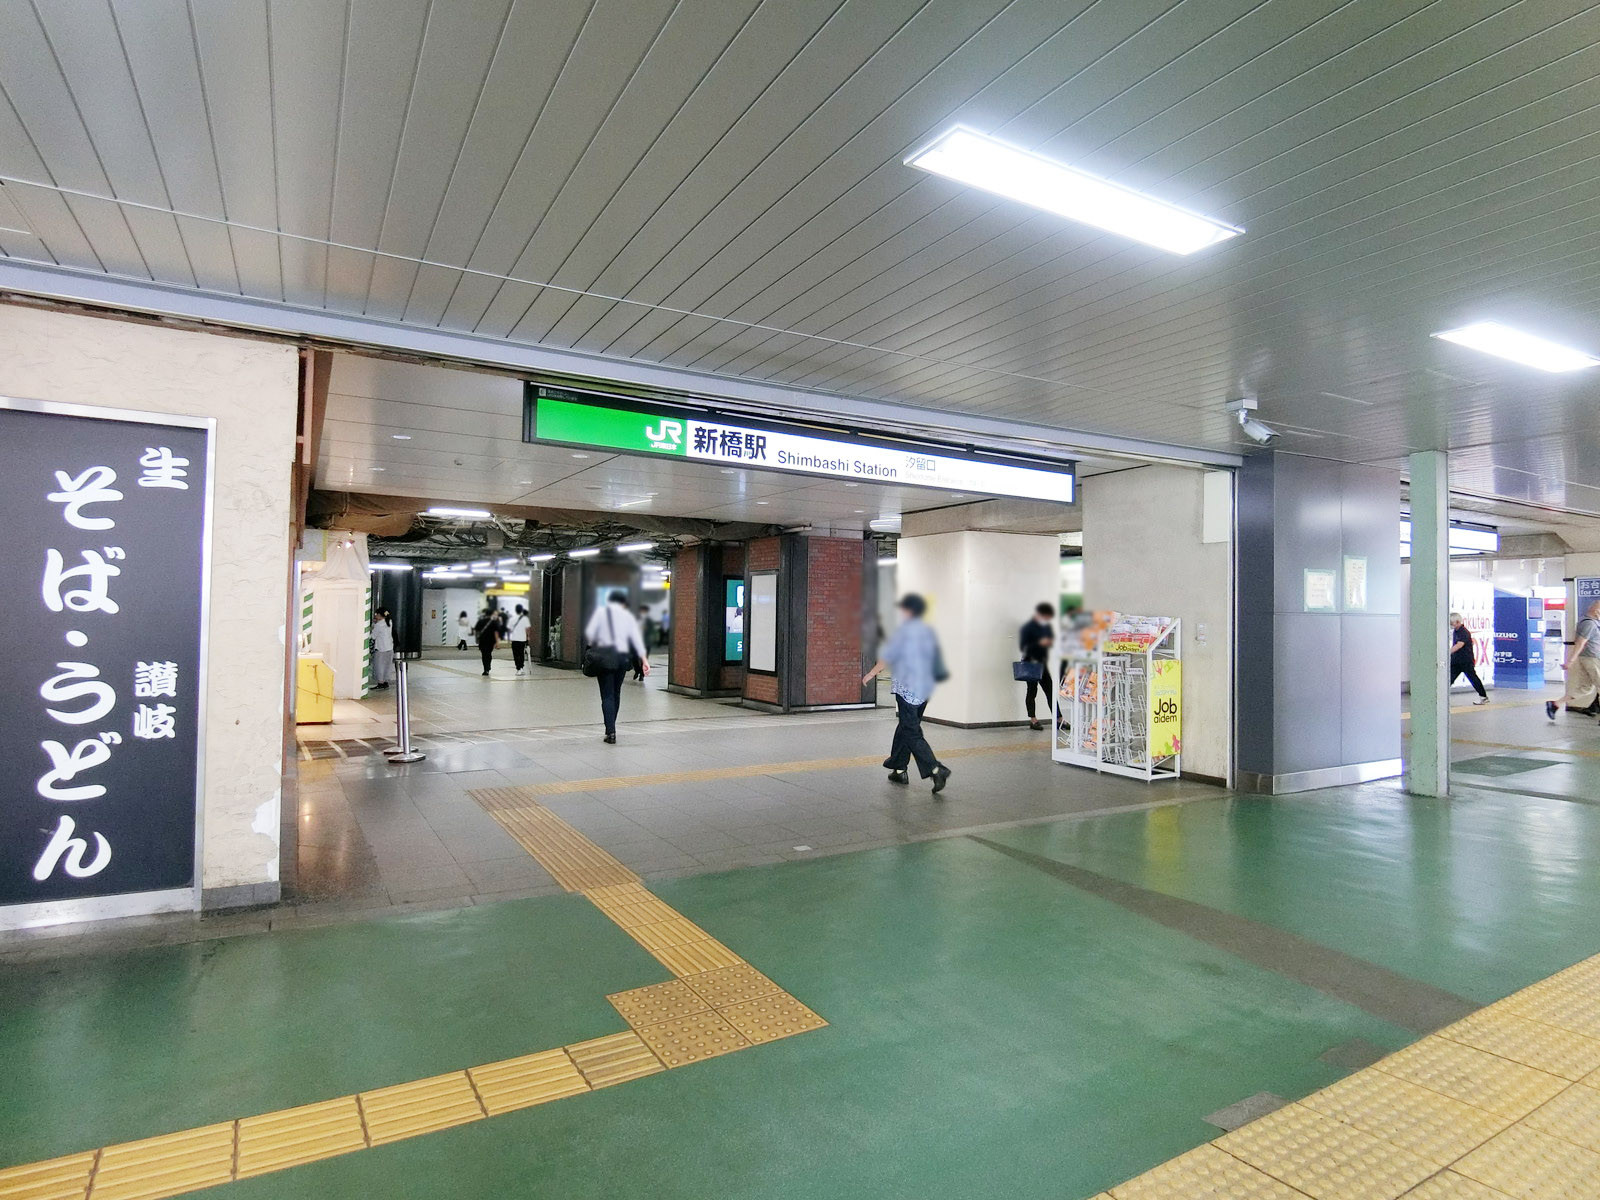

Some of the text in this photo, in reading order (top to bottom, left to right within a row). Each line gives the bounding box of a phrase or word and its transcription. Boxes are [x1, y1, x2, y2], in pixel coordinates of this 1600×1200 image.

[645, 420, 682, 444] JR
[693, 426, 767, 461] 新橋駅
[137, 446, 190, 491] 生
[777, 449, 850, 472] Shimbashi
[853, 460, 898, 479] Station
[905, 455, 936, 472] 汐留口
[33, 465, 126, 881] そば・うどん
[1154, 697, 1177, 715] Job
[1154, 714, 1177, 723] aidem
